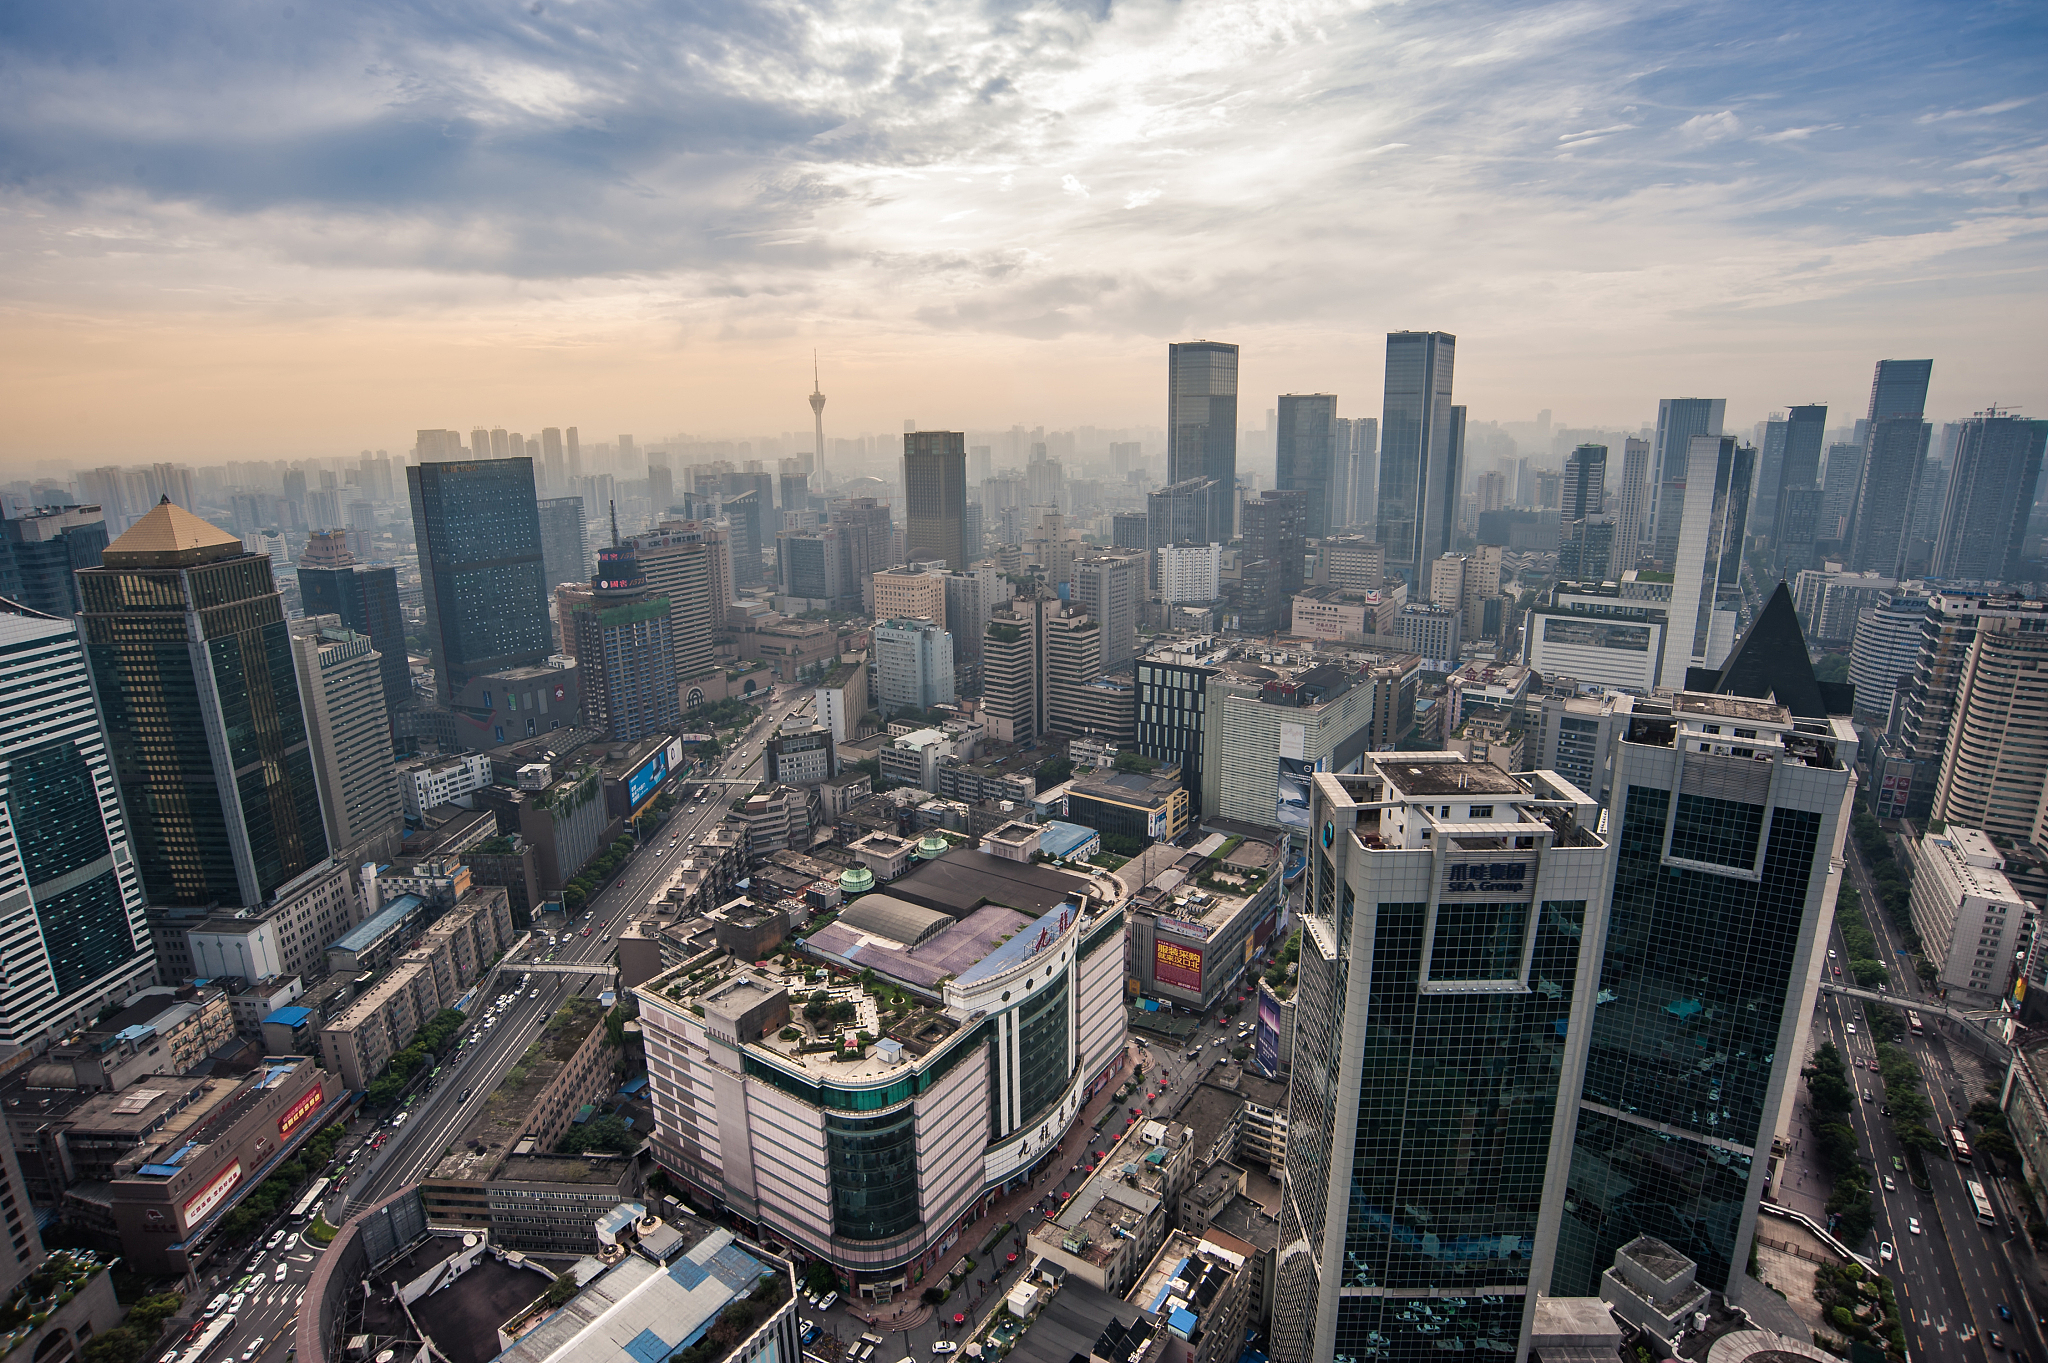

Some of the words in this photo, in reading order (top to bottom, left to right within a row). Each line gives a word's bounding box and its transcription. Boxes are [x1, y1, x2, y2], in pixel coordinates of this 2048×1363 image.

[648, 540, 662, 548] ICBC
[1448, 882, 1476, 892] SEA
[1479, 882, 1524, 893] Group
[1157, 943, 1200, 962] 服装采购
[1157, 952, 1200, 970] 就来汉口北
